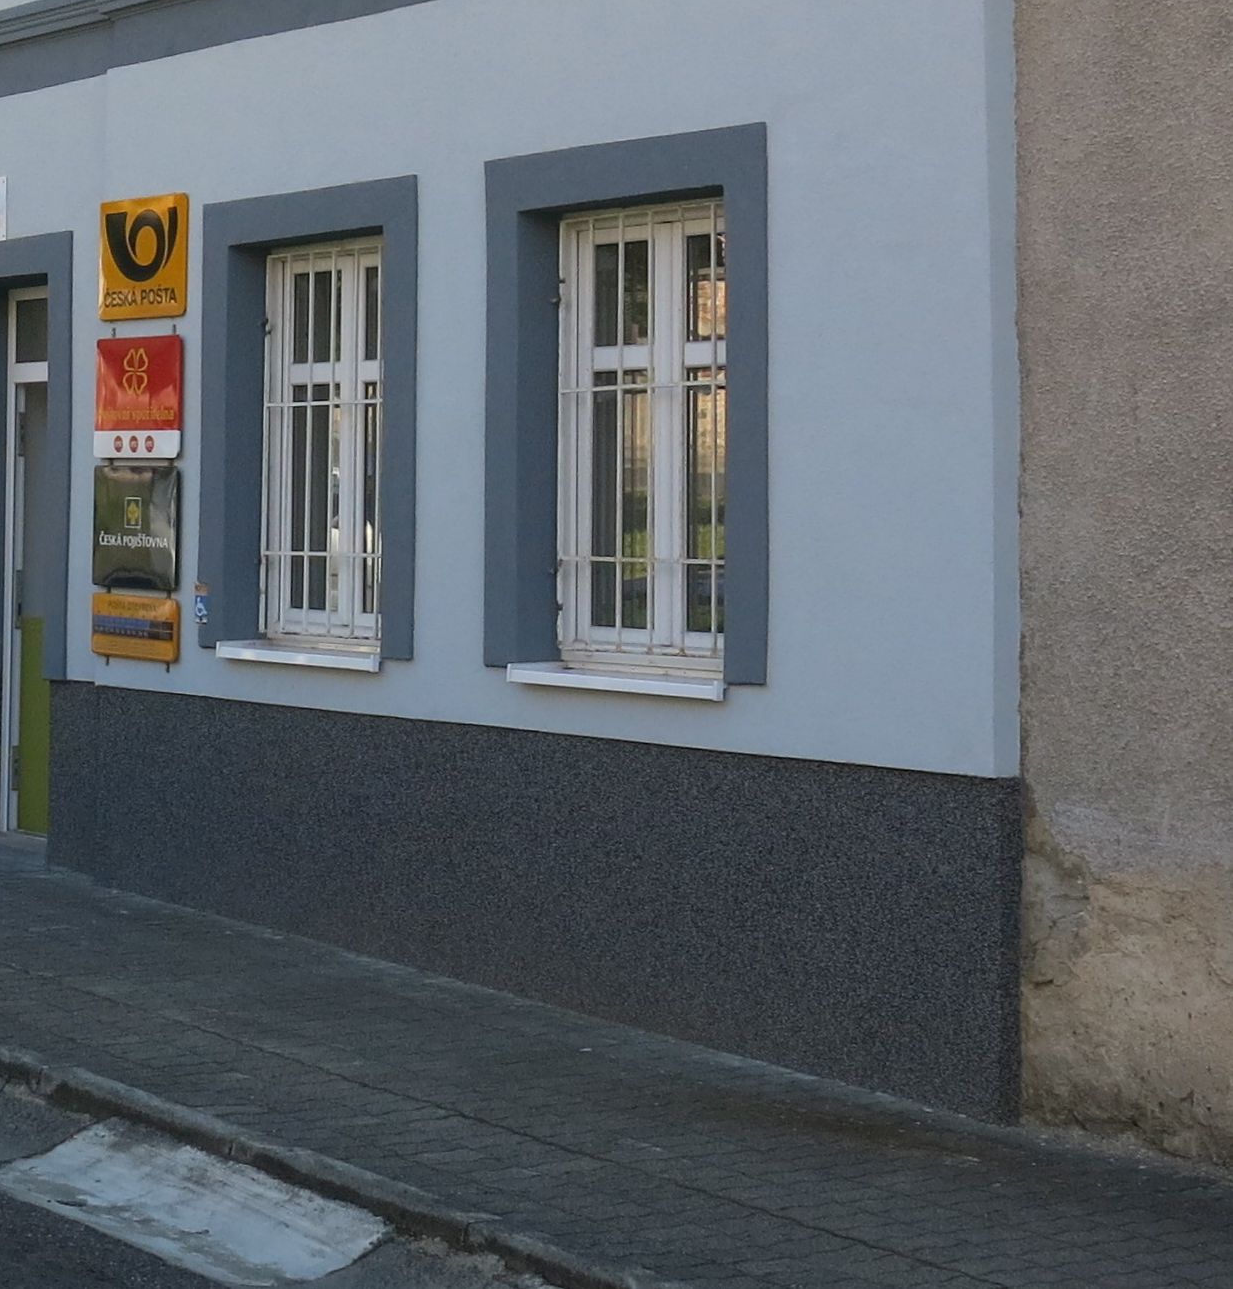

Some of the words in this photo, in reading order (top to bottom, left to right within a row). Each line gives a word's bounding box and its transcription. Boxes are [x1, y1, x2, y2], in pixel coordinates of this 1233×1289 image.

[104, 286, 137, 308] ČESKÁ
[140, 284, 177, 305] POŠTA
[99, 530, 122, 547] ČESKÁ
[123, 532, 168, 549] POJIŠŤOVNA
